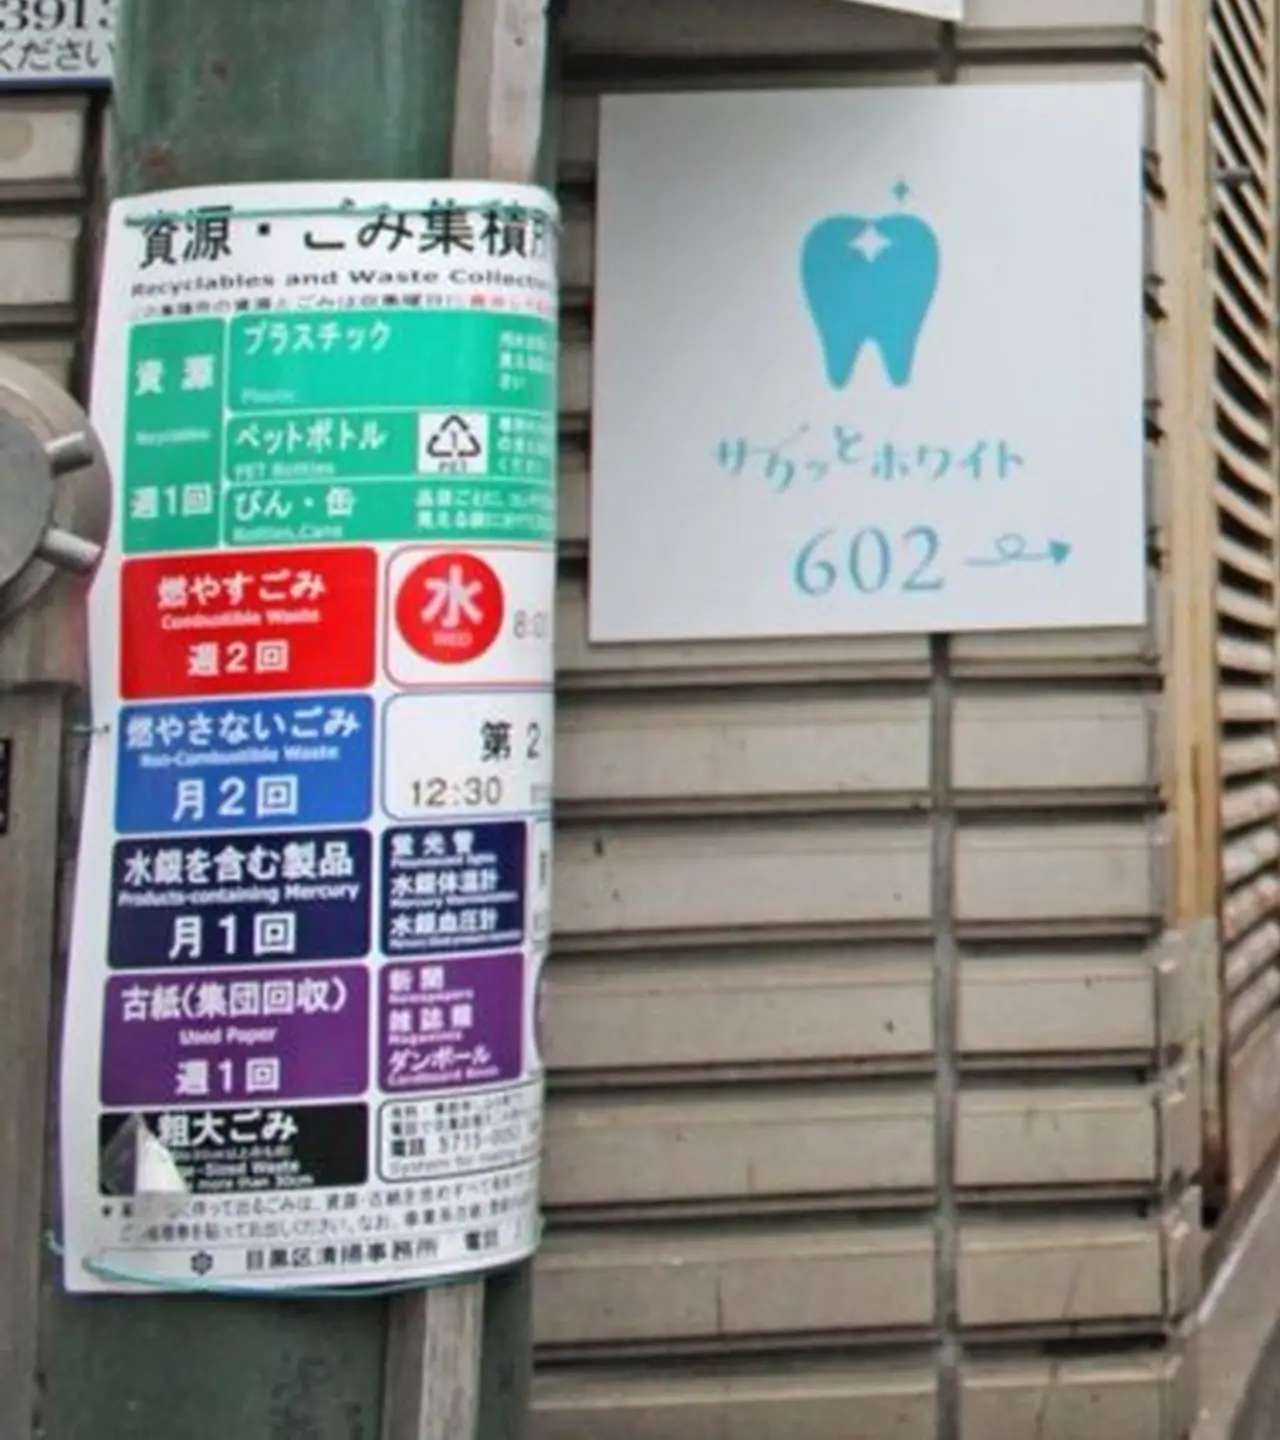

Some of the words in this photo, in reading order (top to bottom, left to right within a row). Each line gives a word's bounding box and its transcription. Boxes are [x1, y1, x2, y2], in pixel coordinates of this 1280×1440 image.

[286, 270, 338, 287] and
[349, 269, 439, 285] Waste
[244, 320, 391, 357] プラスチック
[235, 416, 388, 455] ペットボトル
[234, 486, 358, 522] びん・缶
[793, 524, 946, 598] 602
[158, 569, 326, 609] 燃やすごみ
[420, 564, 484, 628] 水
[187, 639, 290, 678] 週2回
[127, 706, 361, 749] 燃やさないごみ
[172, 774, 299, 823] 月2回
[411, 776, 503, 807] 12:30
[124, 840, 354, 886] 水銀を含む製品
[168, 912, 296, 960] 月1回
[175, 1057, 280, 1096] 週1回
